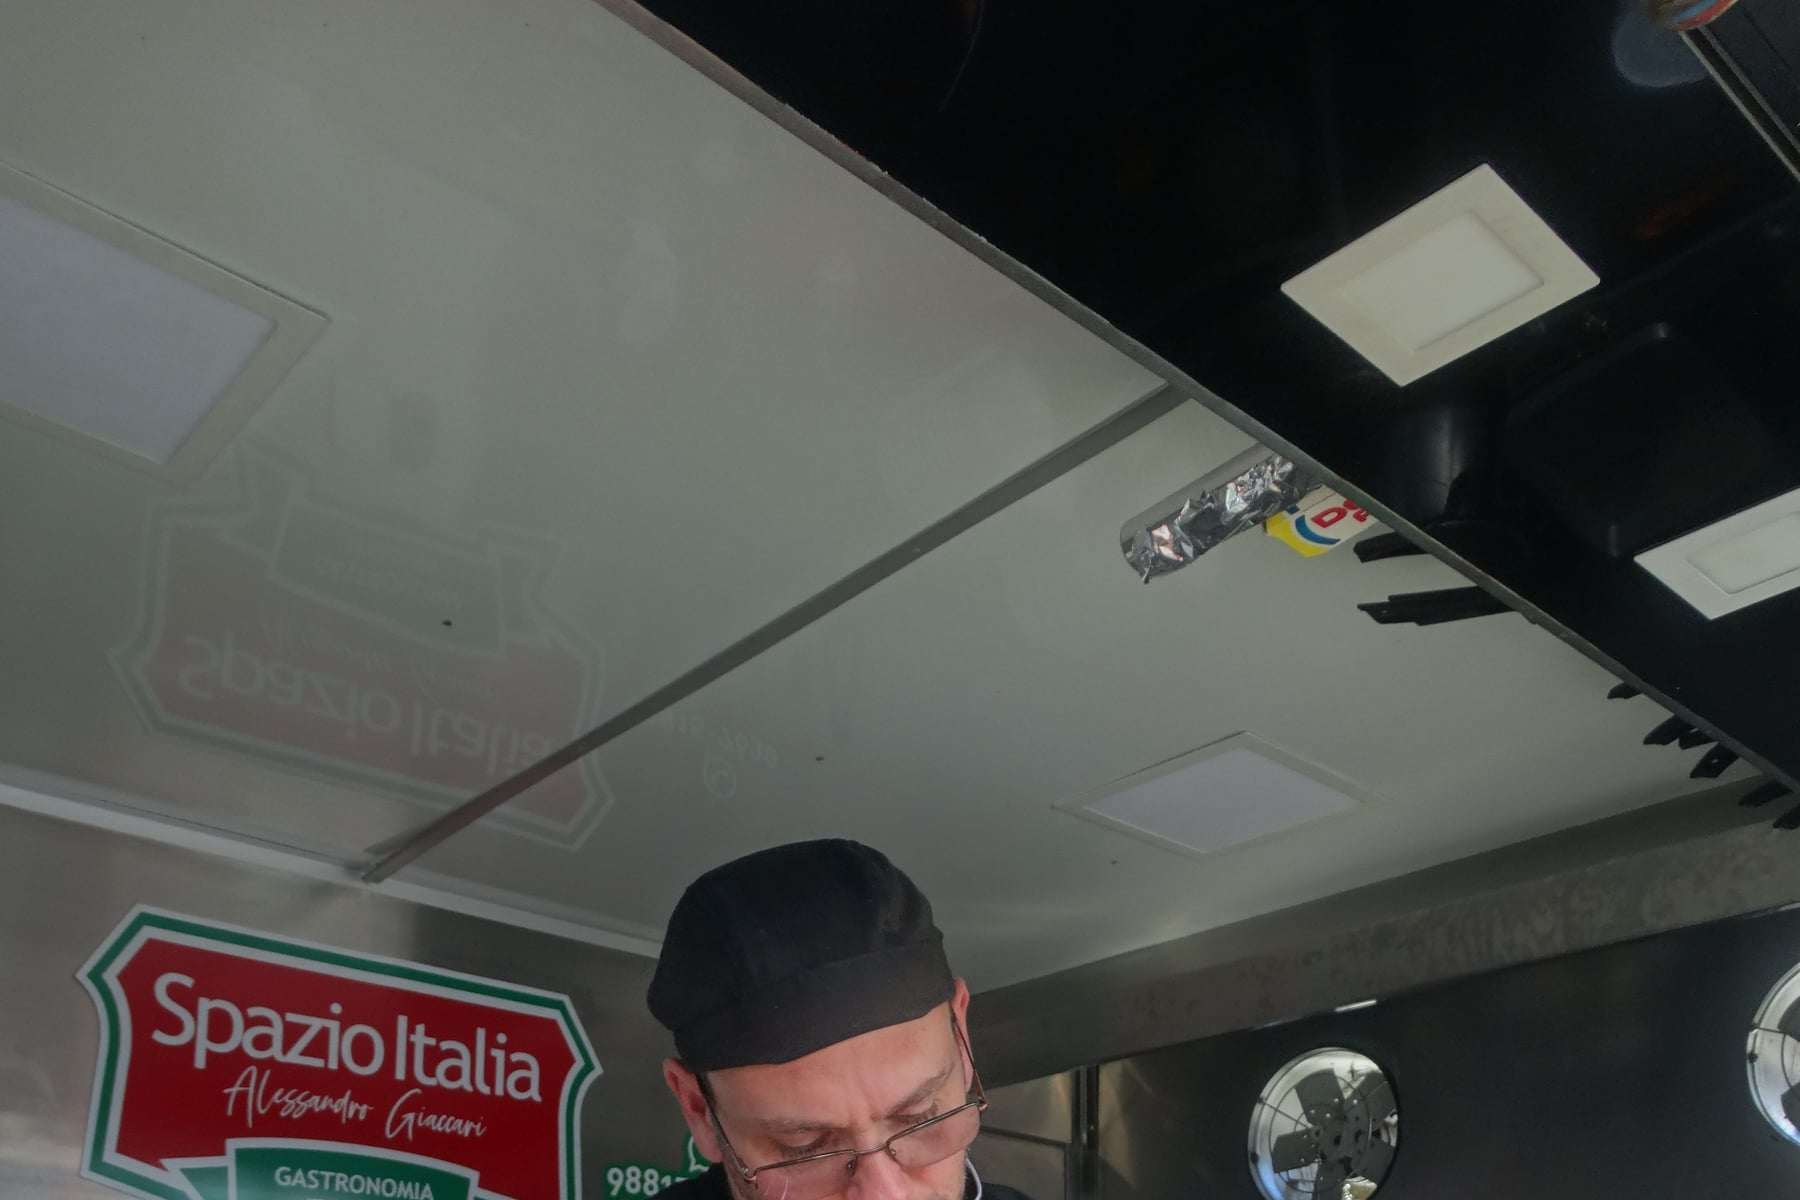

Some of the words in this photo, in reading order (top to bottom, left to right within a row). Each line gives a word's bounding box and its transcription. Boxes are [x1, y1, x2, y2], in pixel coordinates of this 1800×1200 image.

[152, 972, 385, 1075] Spazio
[394, 1014, 542, 1102] Italia
[224, 1065, 374, 1128] Alessandro
[384, 1088, 487, 1141] Giaccari
